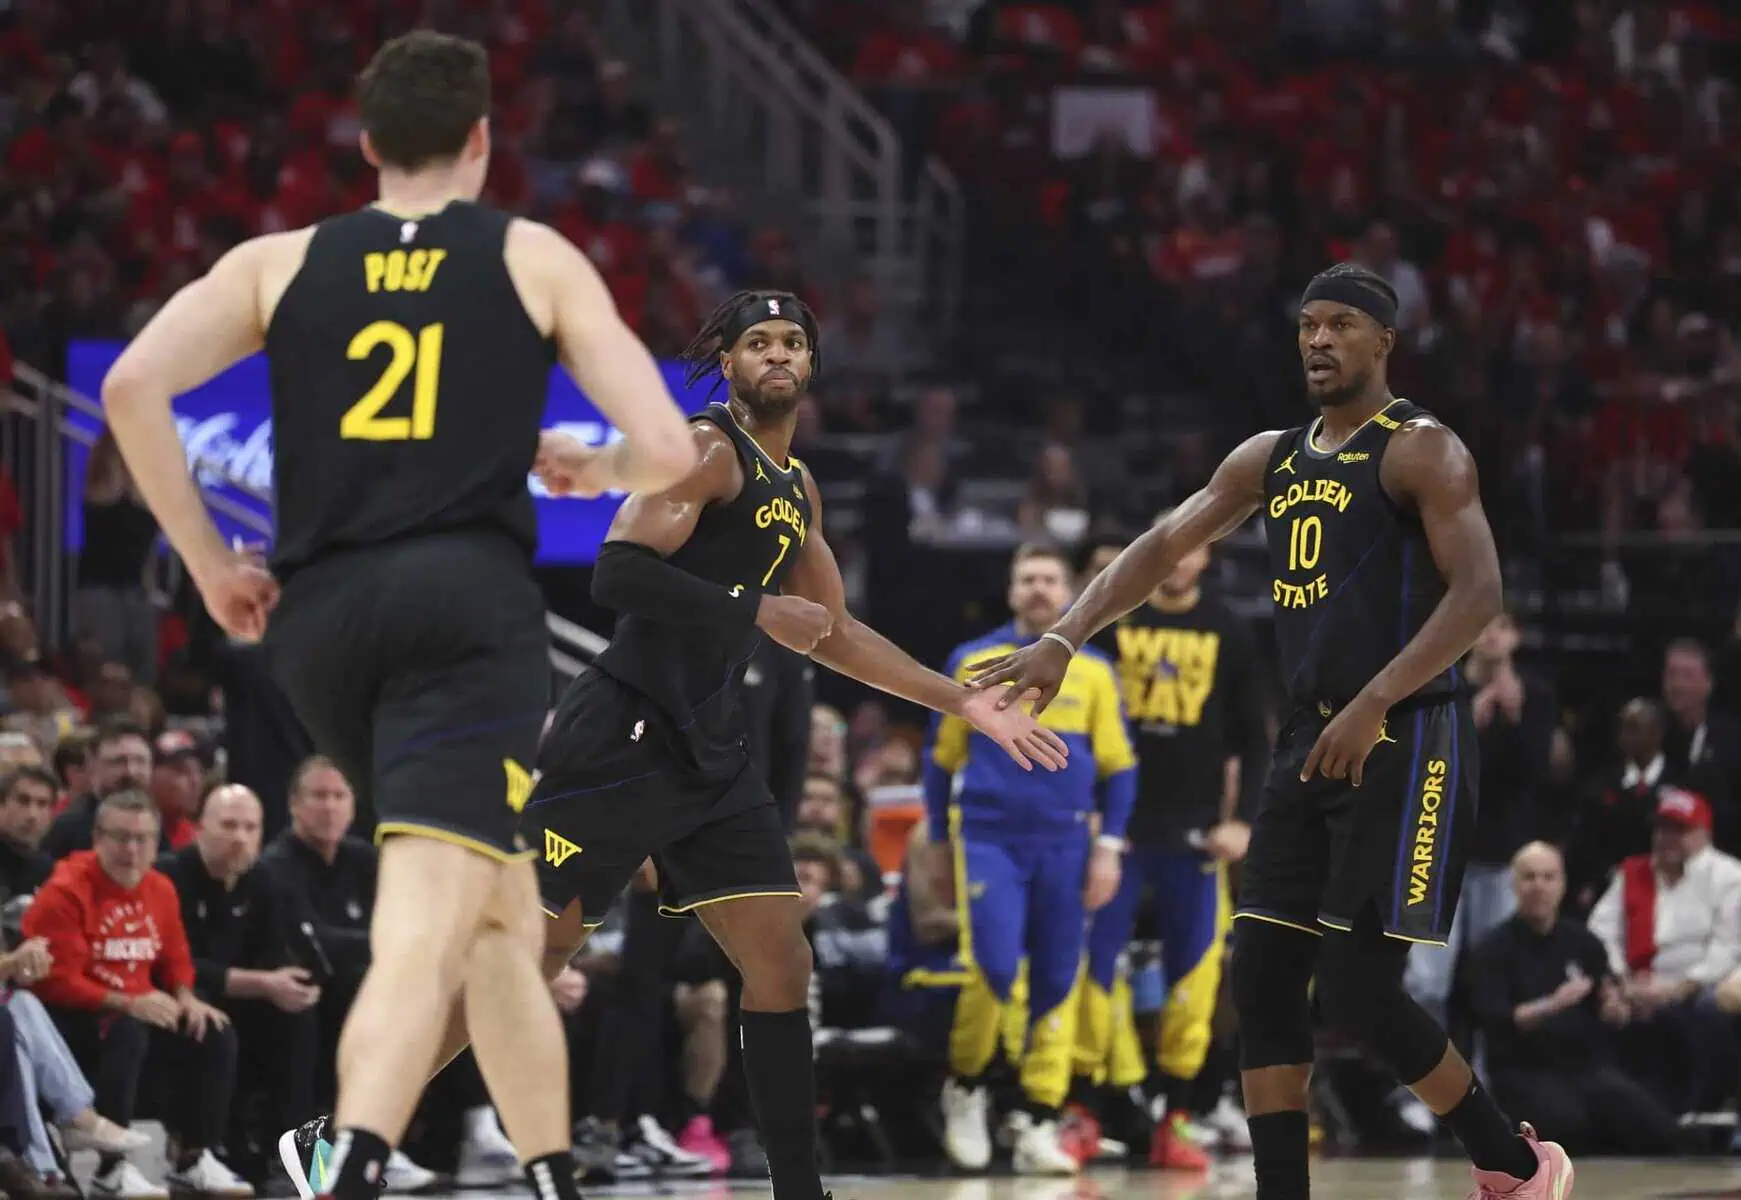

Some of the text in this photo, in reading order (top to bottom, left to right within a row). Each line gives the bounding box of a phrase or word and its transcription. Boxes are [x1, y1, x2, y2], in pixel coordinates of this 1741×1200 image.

[364, 249, 447, 293] POST
[340, 320, 444, 441] 21
[1337, 452, 1370, 463] Rakuten
[1270, 479, 1353, 518] GOLDEN
[761, 534, 791, 587] 7
[1289, 515, 1322, 570] 10
[1273, 573, 1329, 609] STATE
[1407, 759, 1446, 906] WARRIORS
